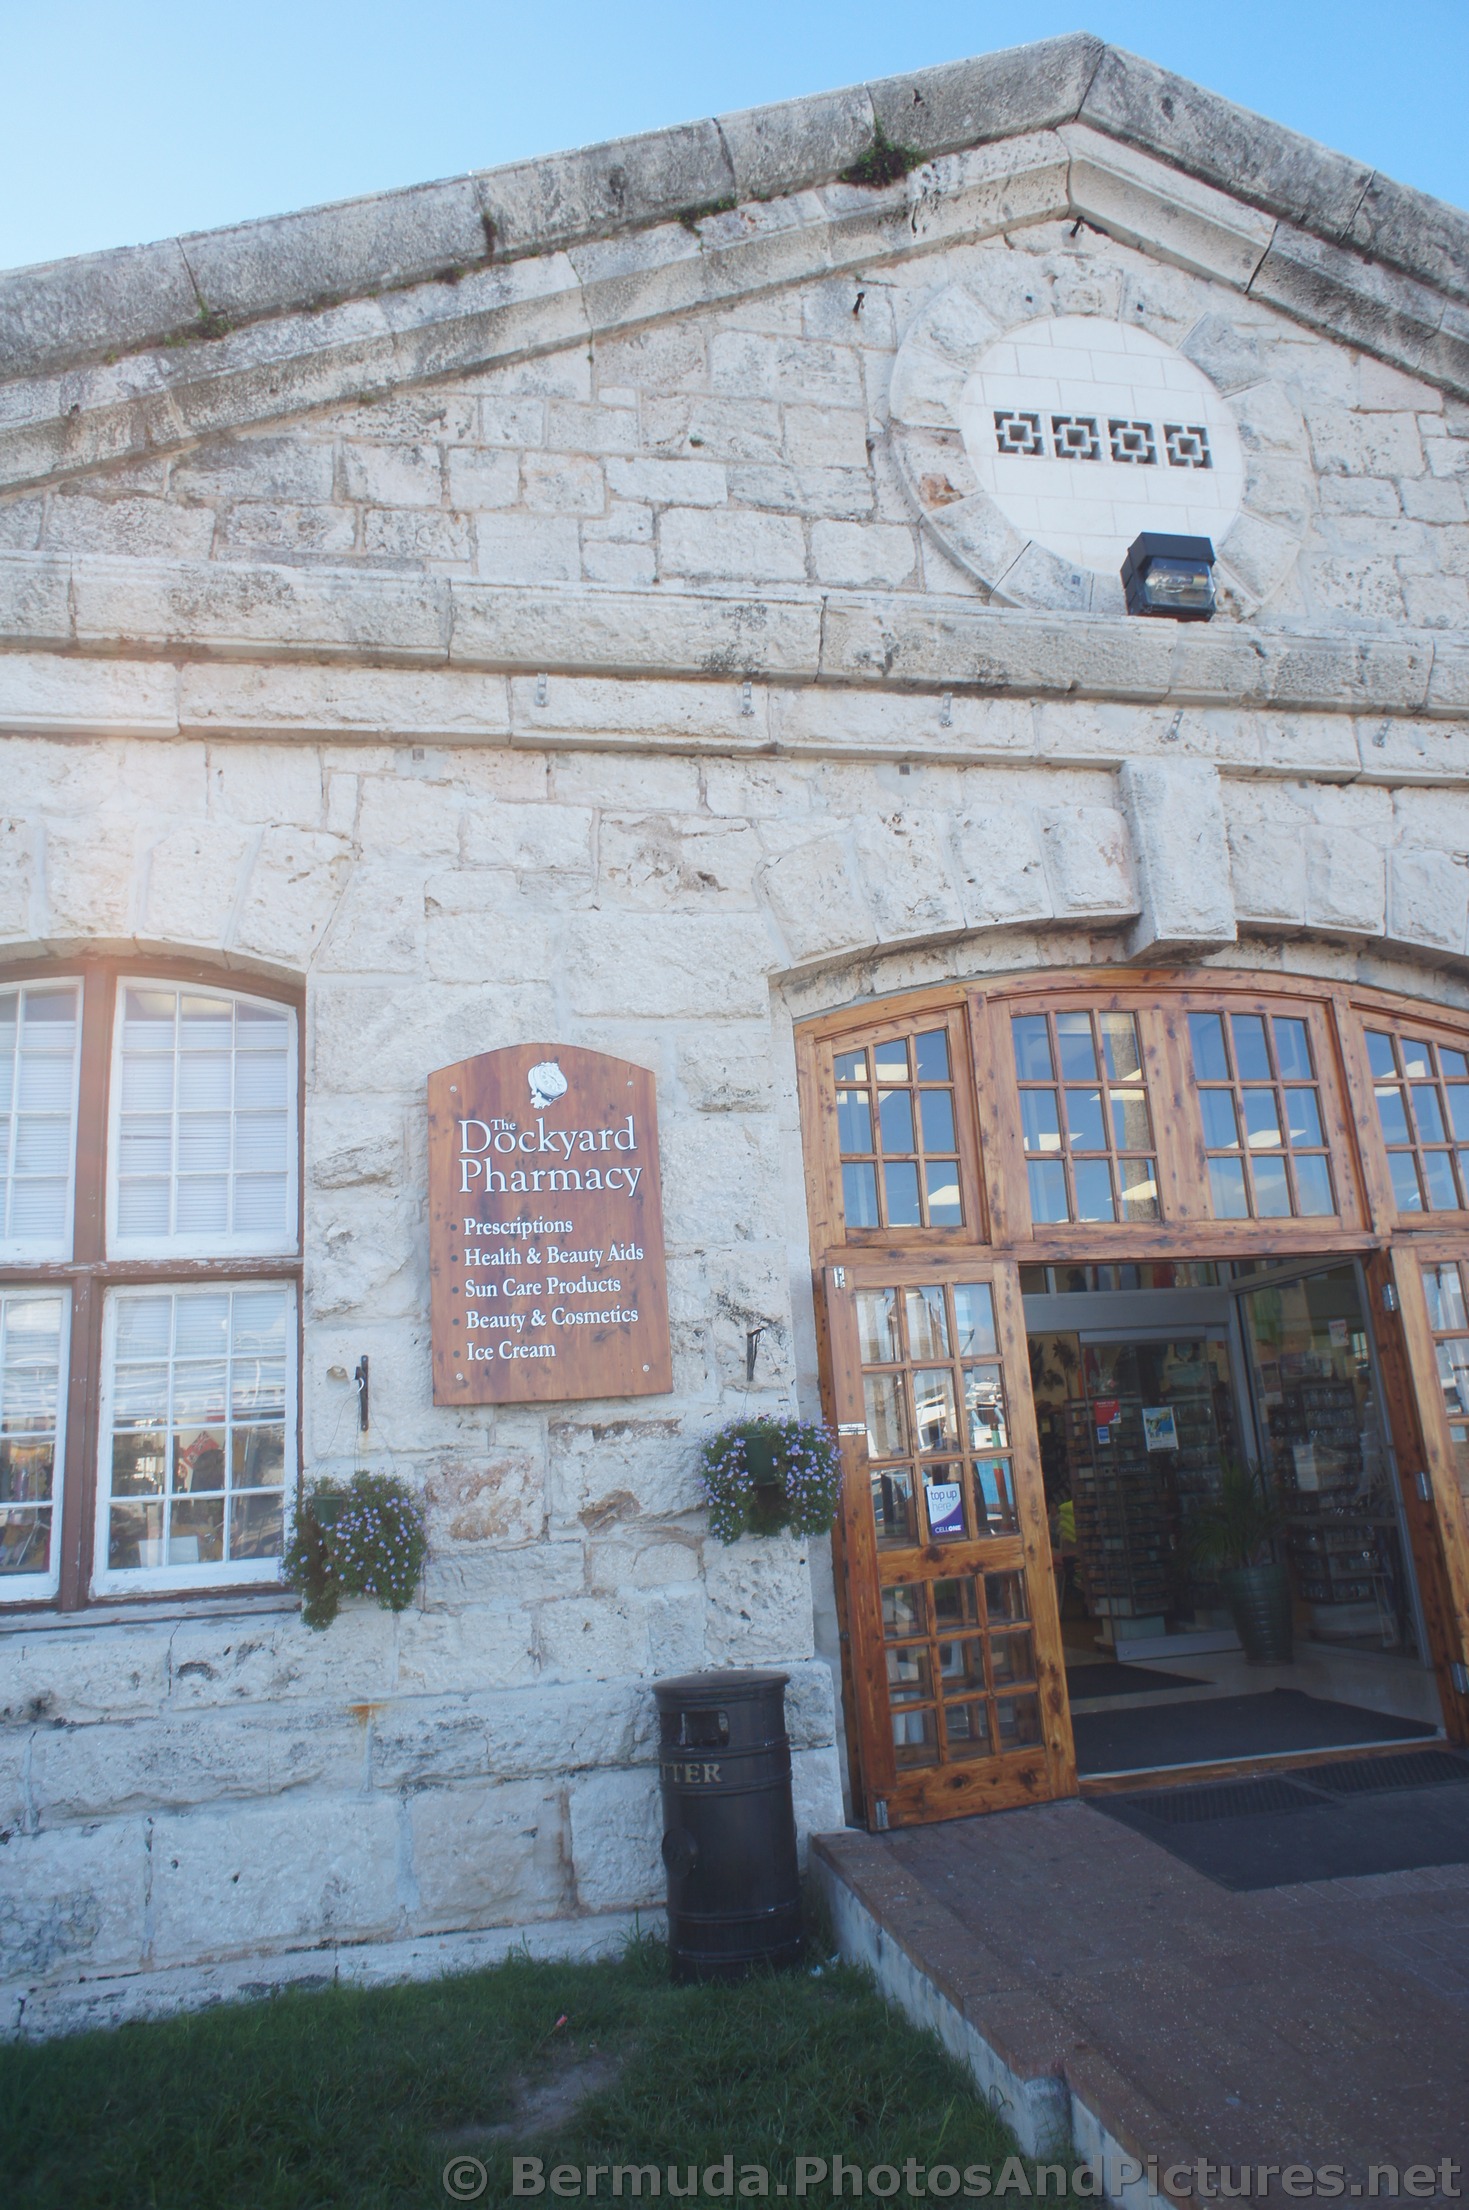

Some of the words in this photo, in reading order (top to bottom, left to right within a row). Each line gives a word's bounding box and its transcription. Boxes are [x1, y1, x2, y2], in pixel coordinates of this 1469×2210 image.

[491, 1119, 517, 1131] The
[458, 1115, 638, 1161] Dockyard
[458, 1157, 643, 1197] Pharmacy
[463, 1216, 573, 1240] Prescriptions
[464, 1248, 522, 1266] Health
[526, 1247, 542, 1265] &
[546, 1246, 604, 1268] Beauty
[607, 1243, 644, 1262] Aids
[465, 1279, 498, 1298] Sun
[502, 1278, 542, 1296] Care
[546, 1275, 621, 1295] Products
[466, 1310, 526, 1333] Beauty
[530, 1309, 547, 1327] &
[551, 1305, 639, 1326] Cosmetics
[467, 1342, 494, 1361] Ice
[498, 1340, 557, 1360] Cream
[930, 1491, 945, 1502] top
[946, 1490, 958, 1501] up
[932, 1501, 952, 1512] here
